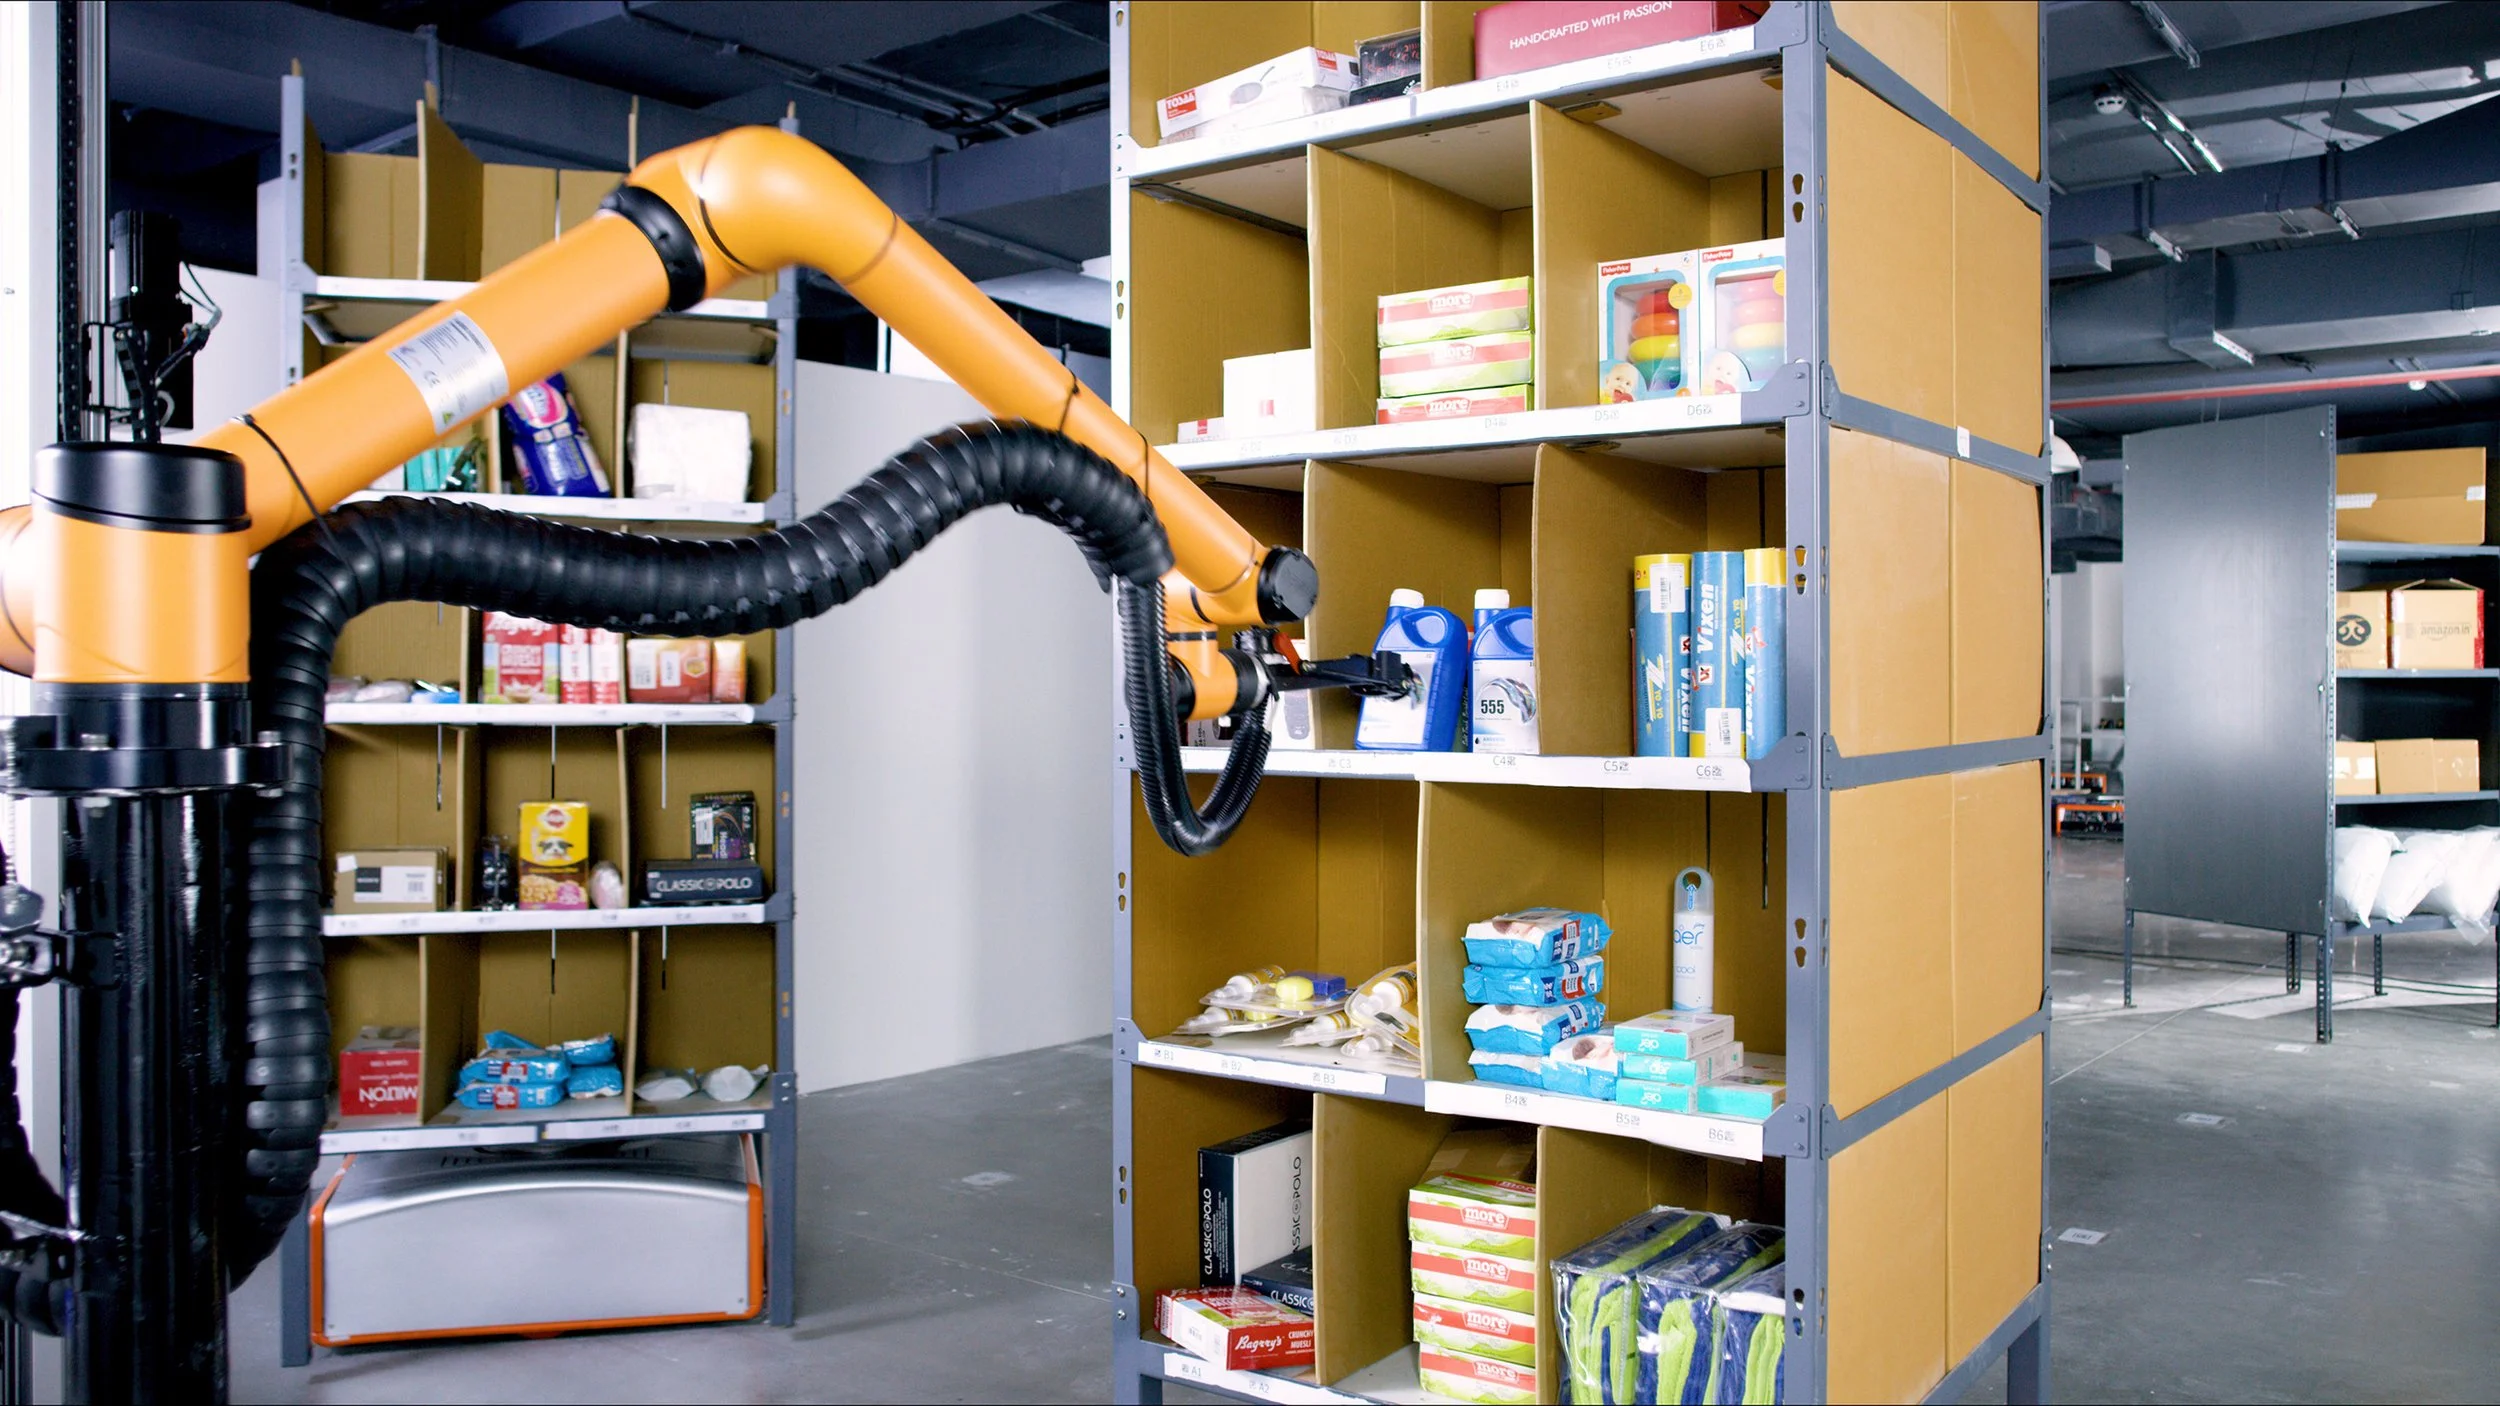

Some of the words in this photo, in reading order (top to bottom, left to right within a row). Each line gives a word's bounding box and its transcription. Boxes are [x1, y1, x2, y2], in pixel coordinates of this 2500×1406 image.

[1509, 20, 1589, 50] HANDCRAFTED
[1591, 12, 1620, 28] WITH
[1623, 1, 1672, 21] PASSION
[1431, 293, 1472, 306] more
[1428, 398, 1469, 412] more
[1697, 583, 1715, 654] Vixen
[1480, 699, 1505, 714] 555
[1493, 755, 1505, 766] C4
[1604, 760, 1619, 772] C5
[1696, 765, 1711, 777] C6
[655, 879, 704, 892] CLASSIC
[716, 877, 753, 890] POLO
[358, 1085, 417, 1103] MILTON
[1504, 1094, 1518, 1105] B4
[1616, 1113, 1630, 1125] B5
[1709, 1128, 1723, 1140] B6
[1292, 1156, 1302, 1200] POLO
[1203, 1188, 1212, 1220] POLO
[1464, 1206, 1506, 1224] more
[1203, 1232, 1213, 1276] CLASSIC
[1465, 1258, 1508, 1277] more
[1270, 1290, 1308, 1308] CLASSIC
[1466, 1311, 1509, 1330] more
[1475, 1362, 1517, 1379] more
